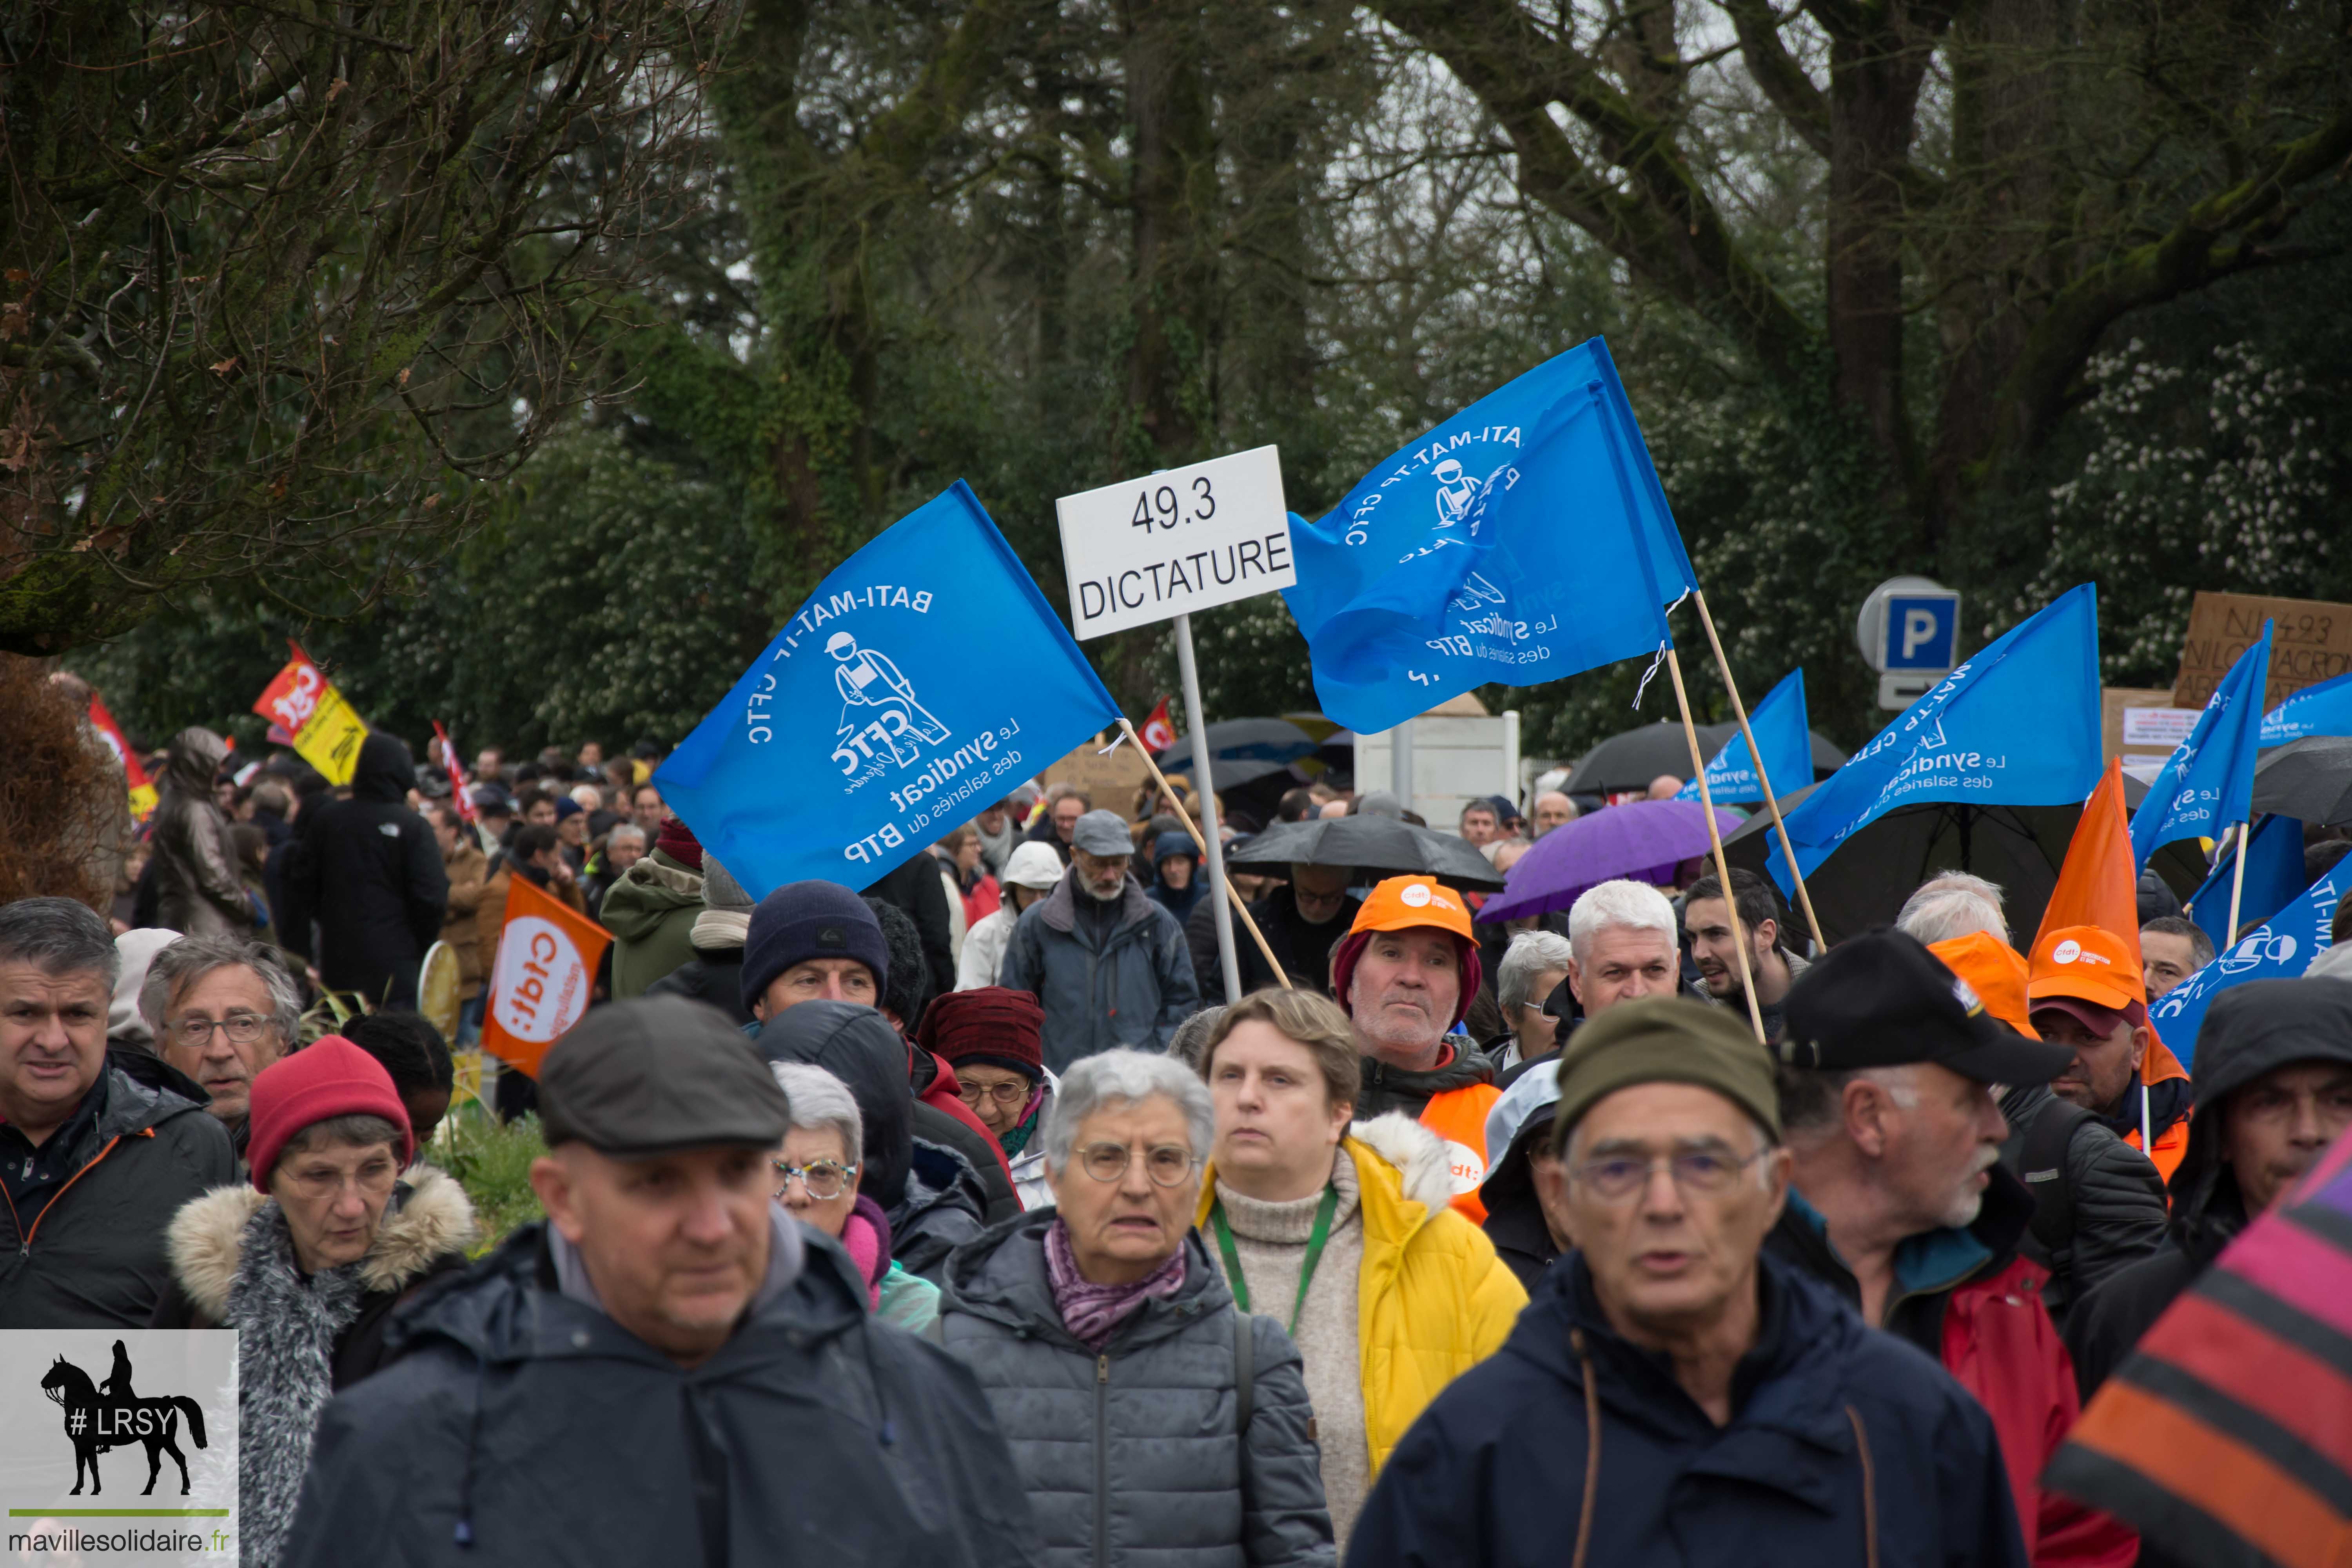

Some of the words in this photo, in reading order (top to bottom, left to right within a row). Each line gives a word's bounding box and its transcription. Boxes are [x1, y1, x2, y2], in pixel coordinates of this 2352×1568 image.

[1131, 476, 1217, 534] 49.3
[1079, 532, 1290, 621] DICTATURE
[1902, 608, 1937, 659] P
